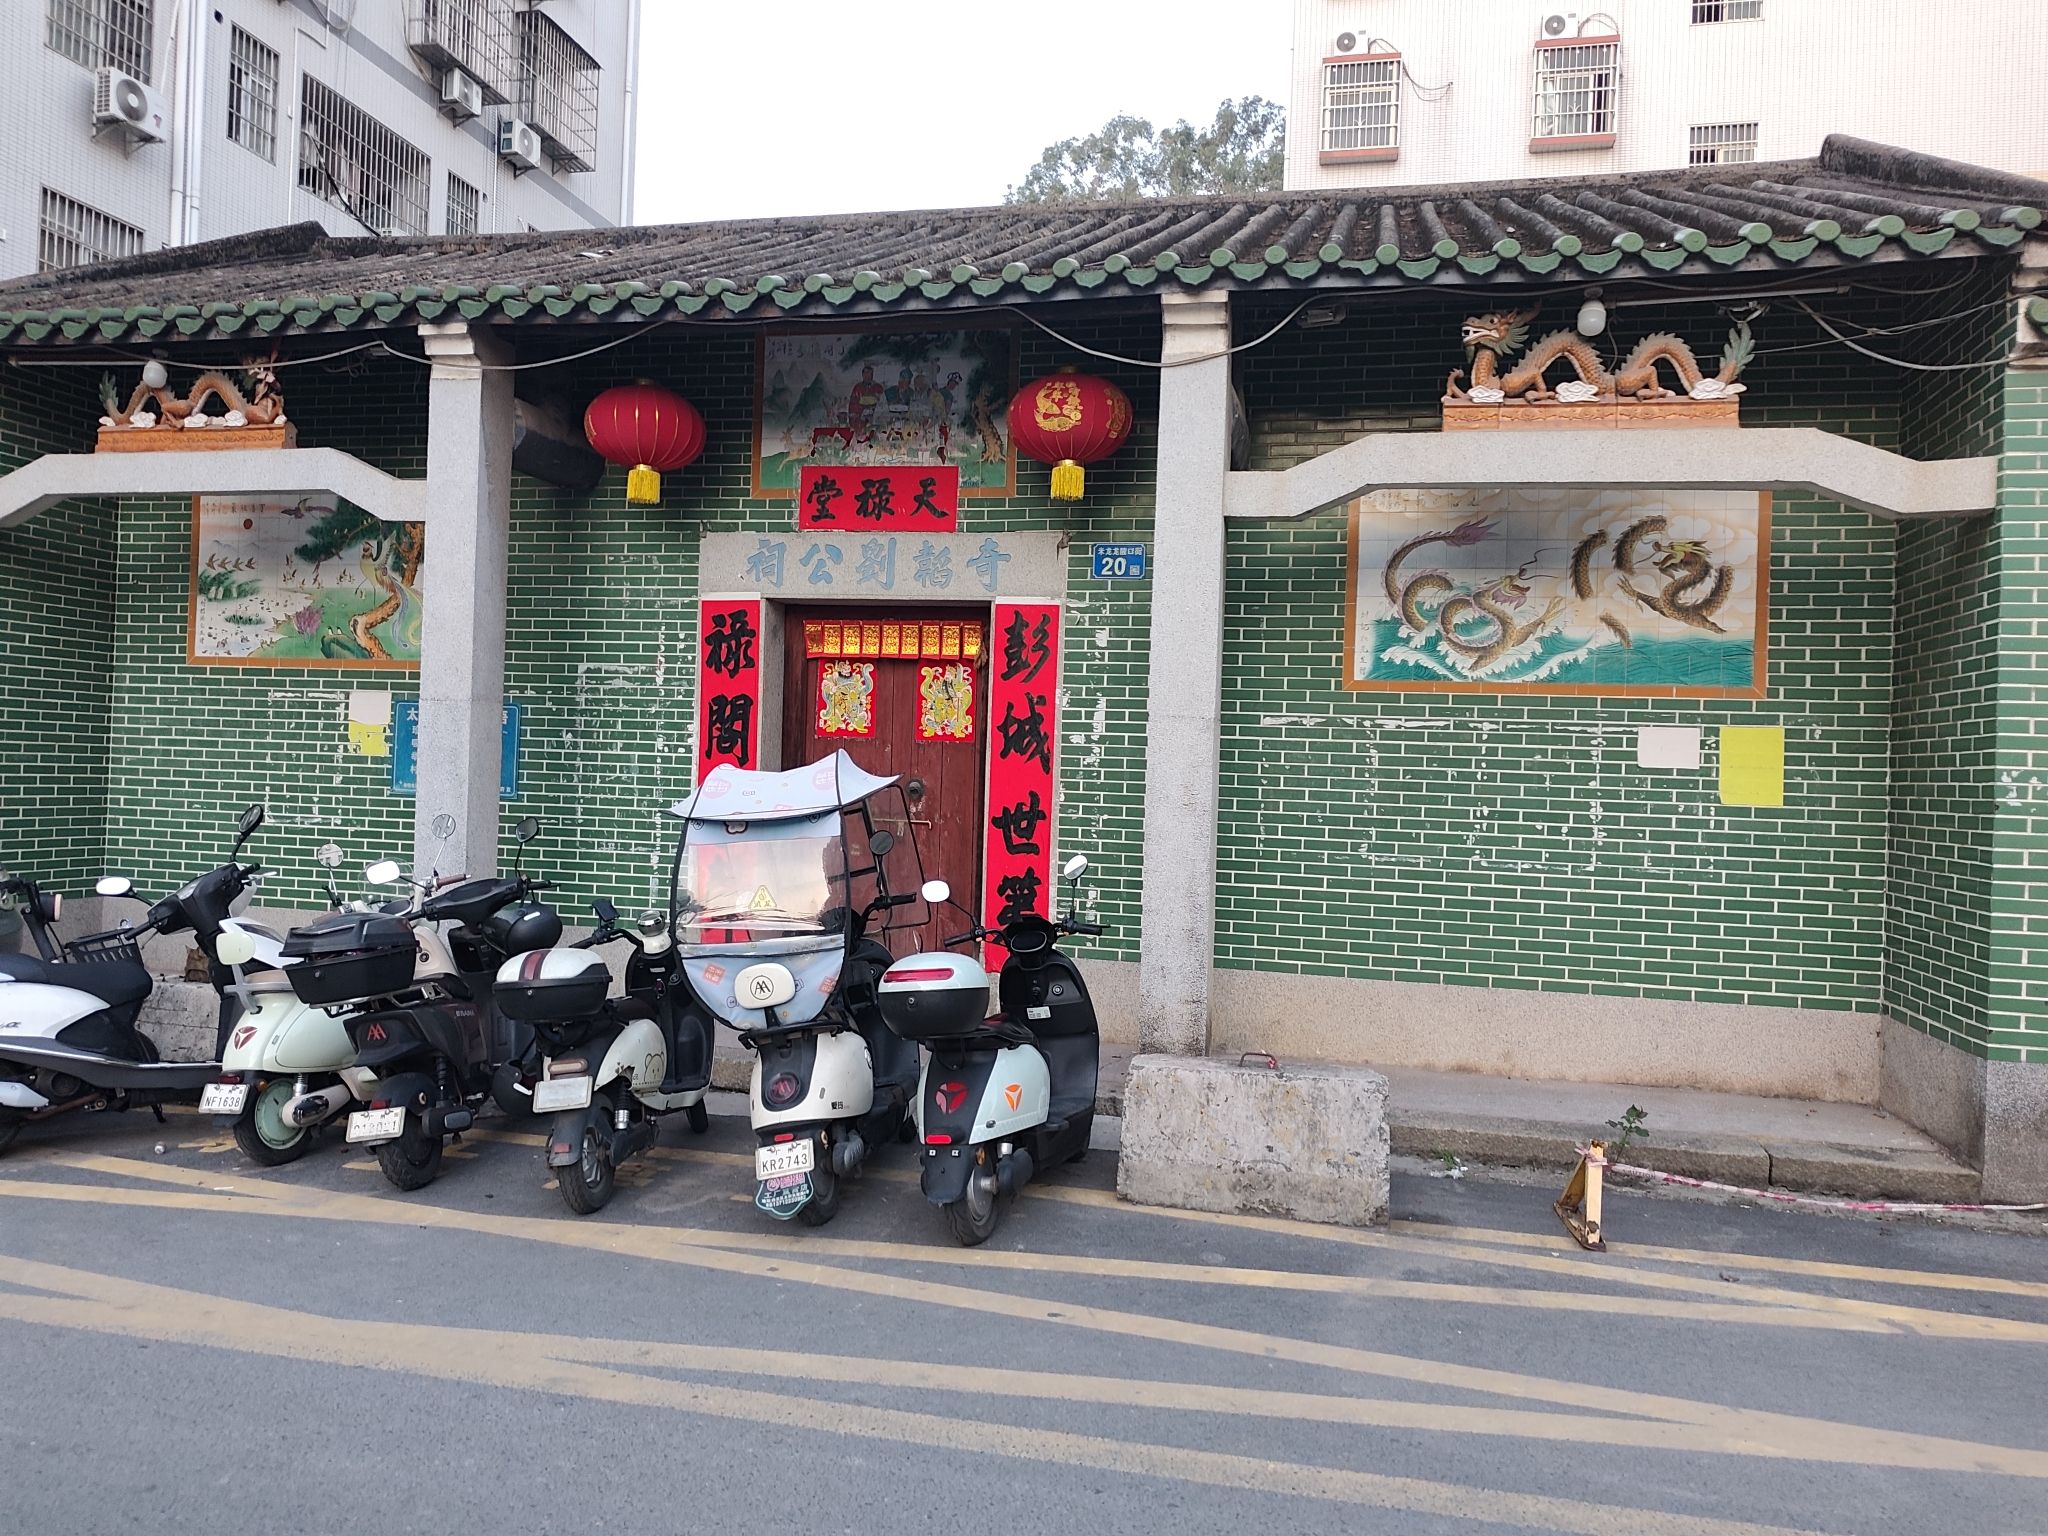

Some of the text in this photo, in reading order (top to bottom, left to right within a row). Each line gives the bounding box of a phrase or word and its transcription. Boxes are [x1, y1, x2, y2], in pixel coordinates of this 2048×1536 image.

[1101, 557, 1127, 576] 20
[204, 1096, 241, 1108] NF1638
[762, 1153, 808, 1173] KR2743
